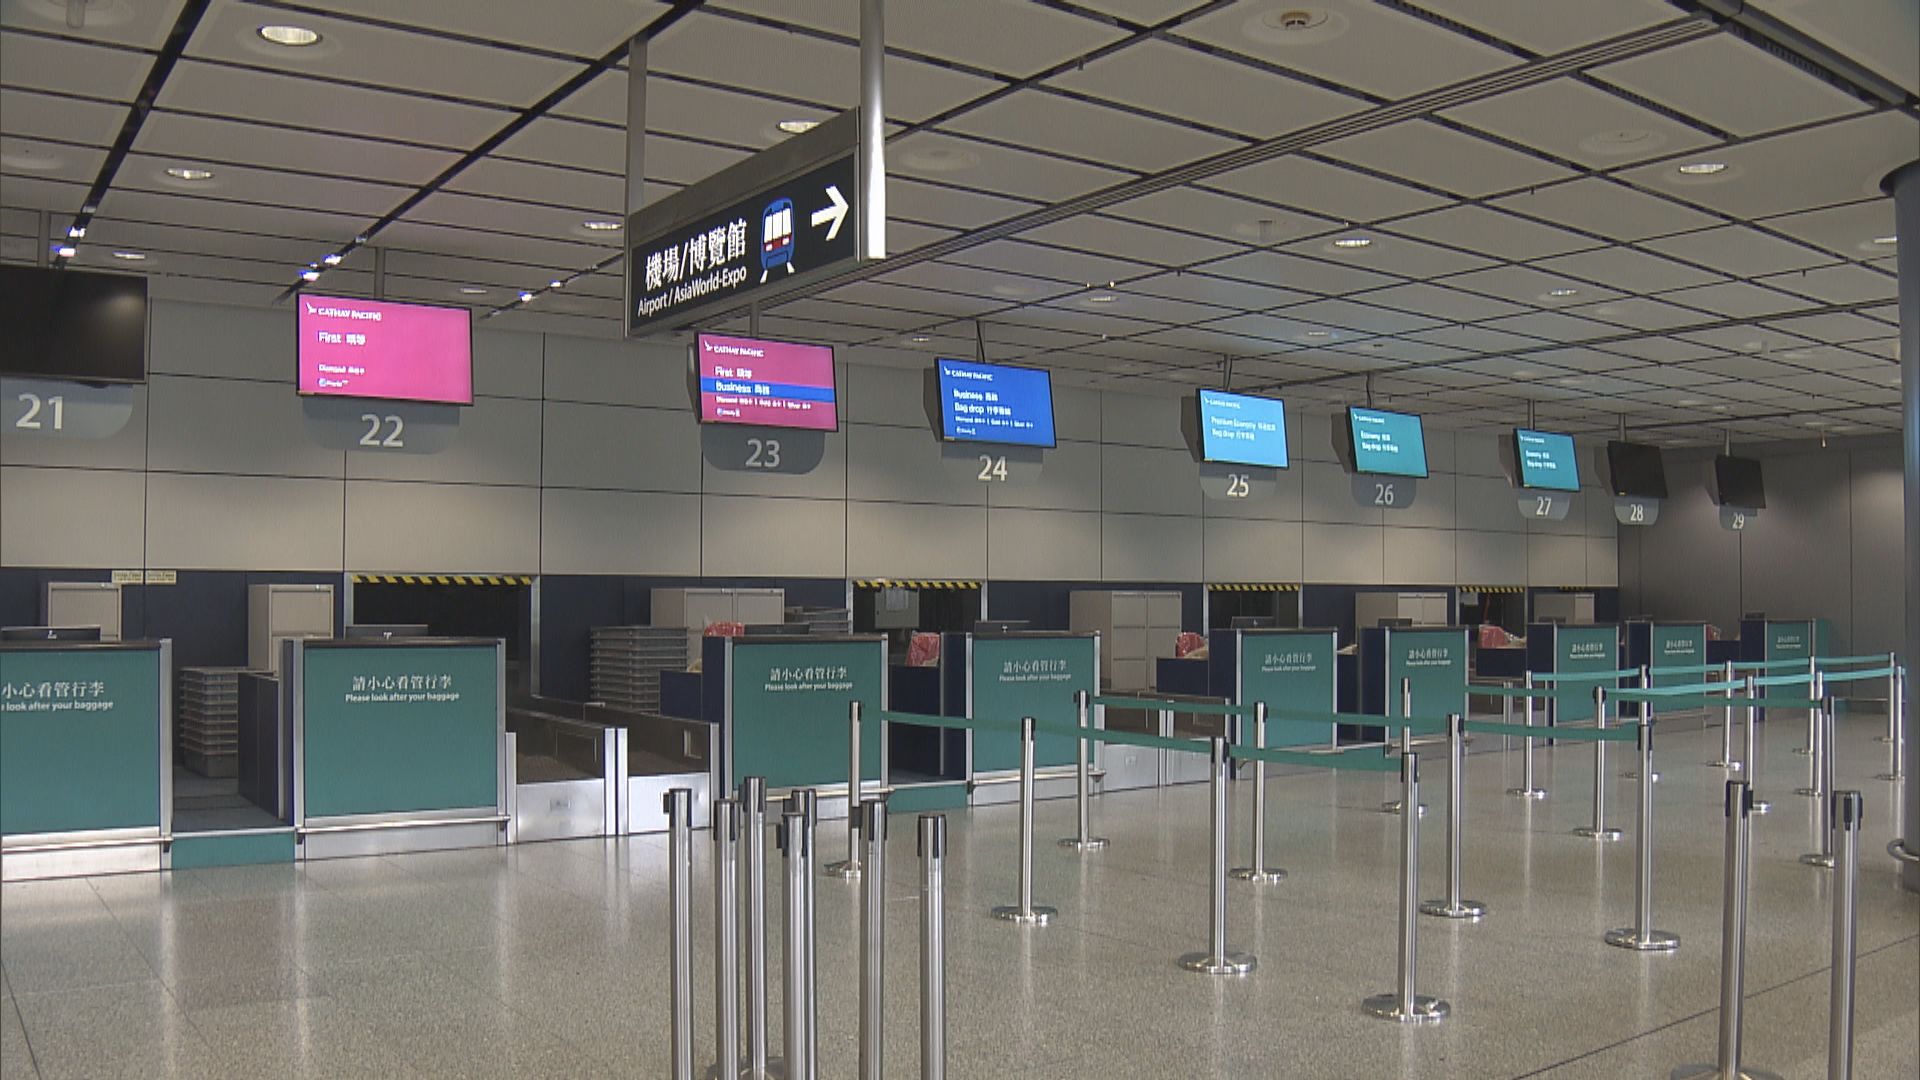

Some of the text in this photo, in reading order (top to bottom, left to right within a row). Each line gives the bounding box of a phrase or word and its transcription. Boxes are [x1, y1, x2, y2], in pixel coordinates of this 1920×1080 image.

[645, 217, 747, 291] 機場/博覽館
[637, 290, 668, 318] Airport
[674, 265, 747, 302] AsiaWorld-Expo
[318, 307, 350, 318] CATHAY
[319, 331, 342, 343] First
[714, 345, 739, 355] CATHAY
[715, 366, 733, 378] First
[716, 381, 751, 394] Business
[954, 389, 983, 401] Business
[16, 394, 63, 429] 21
[955, 402, 968, 414] Bag
[969, 403, 985, 415] drop
[360, 414, 403, 447] 22
[745, 438, 780, 467] 23
[978, 454, 1008, 482] 24
[1227, 474, 1249, 497] 25
[1375, 484, 1394, 505] 26
[1536, 496, 1551, 515] 27
[1630, 504, 1644, 521] 28
[1732, 512, 1745, 529] 29
[2, 681, 104, 699] 小心看管行李
[353, 674, 452, 691] 請小心看管行李
[765, 683, 784, 691] Please
[799, 682, 813, 690] after
[827, 682, 853, 691] baggage
[6, 702, 27, 711] look
[28, 701, 50, 711] after
[51, 702, 73, 711] your
[74, 700, 114, 711] baggage
[345, 692, 459, 703] Please look after your baggage
